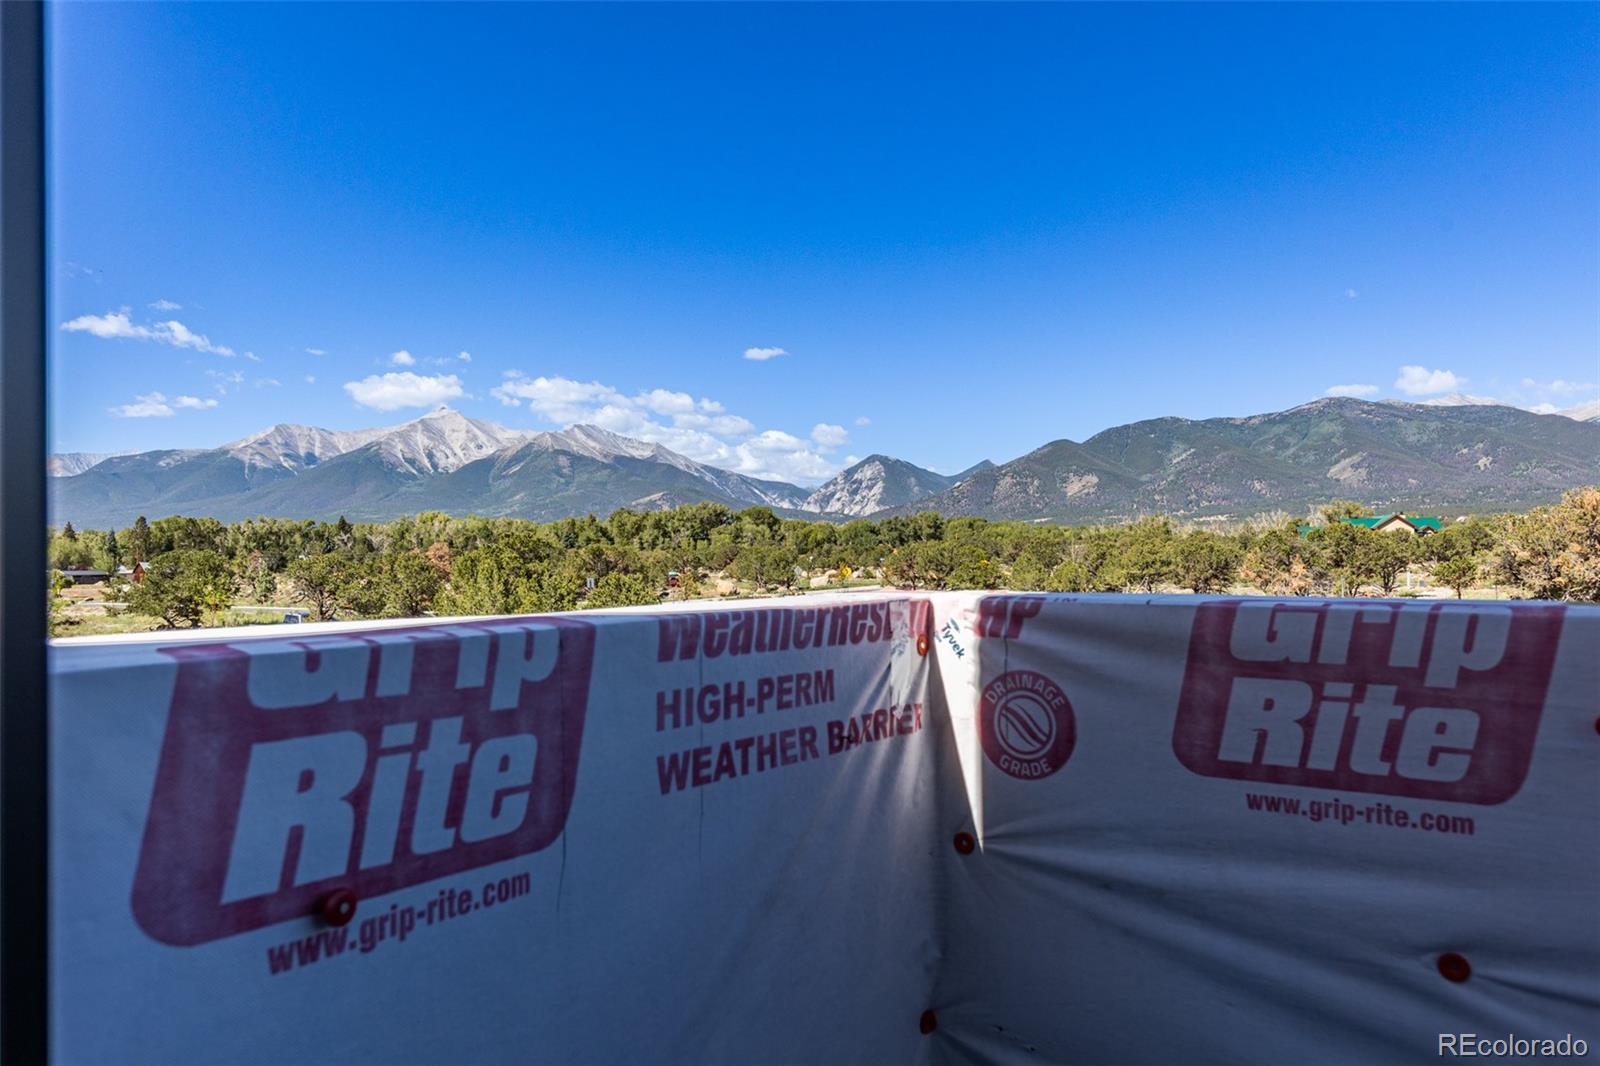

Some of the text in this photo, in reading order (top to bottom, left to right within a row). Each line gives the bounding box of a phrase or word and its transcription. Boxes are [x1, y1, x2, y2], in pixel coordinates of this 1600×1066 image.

[941, 622, 966, 659] Tyvek
[656, 669, 834, 731] HIGH-PERM
[985, 674, 1065, 709] DRAINAGE
[656, 703, 923, 795] WEATHER BARRIER
[1217, 676, 1482, 783] Rite
[1000, 754, 1052, 776] GRADE
[220, 716, 539, 904] Rite
[1246, 792, 1475, 835] www.grip-rite.com
[267, 872, 531, 975] www.grip-rite.com
